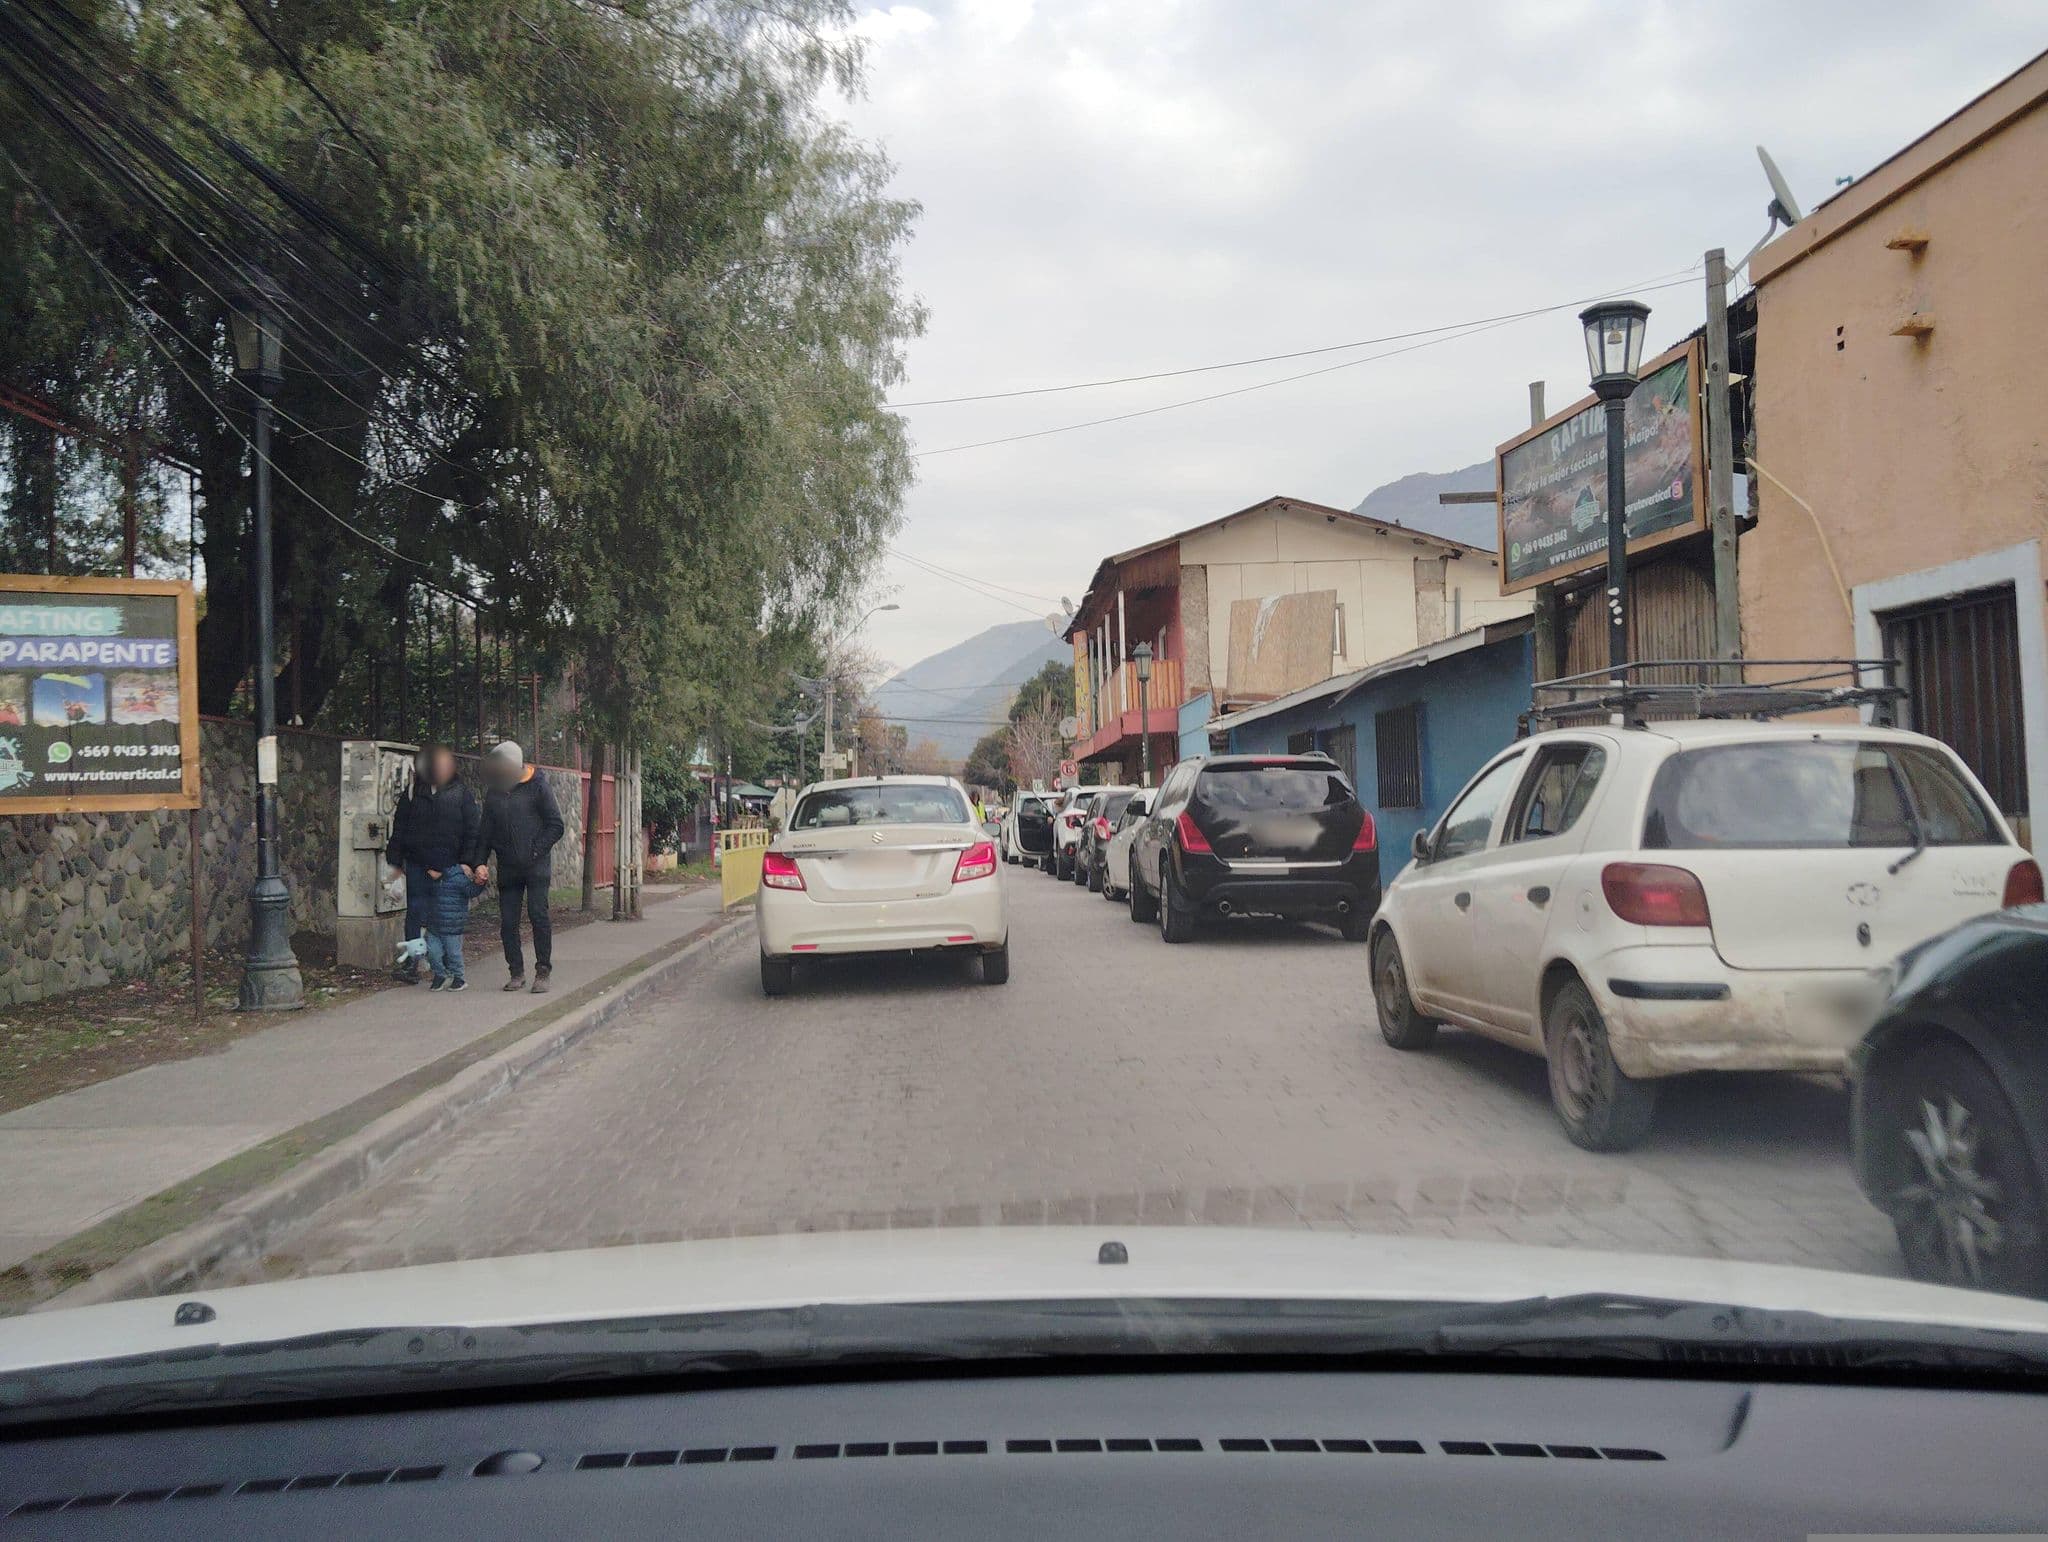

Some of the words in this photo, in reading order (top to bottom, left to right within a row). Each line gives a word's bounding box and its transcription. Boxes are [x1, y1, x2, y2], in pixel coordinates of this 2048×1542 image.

[1551, 402, 1608, 462] RAFTIN
[0, 640, 171, 665] PARAPENTE
[77, 745, 109, 758] +569
[113, 745, 147, 757] 9435
[150, 744, 181, 757] 3143
[44, 768, 182, 782] www.rutavertical.cl
